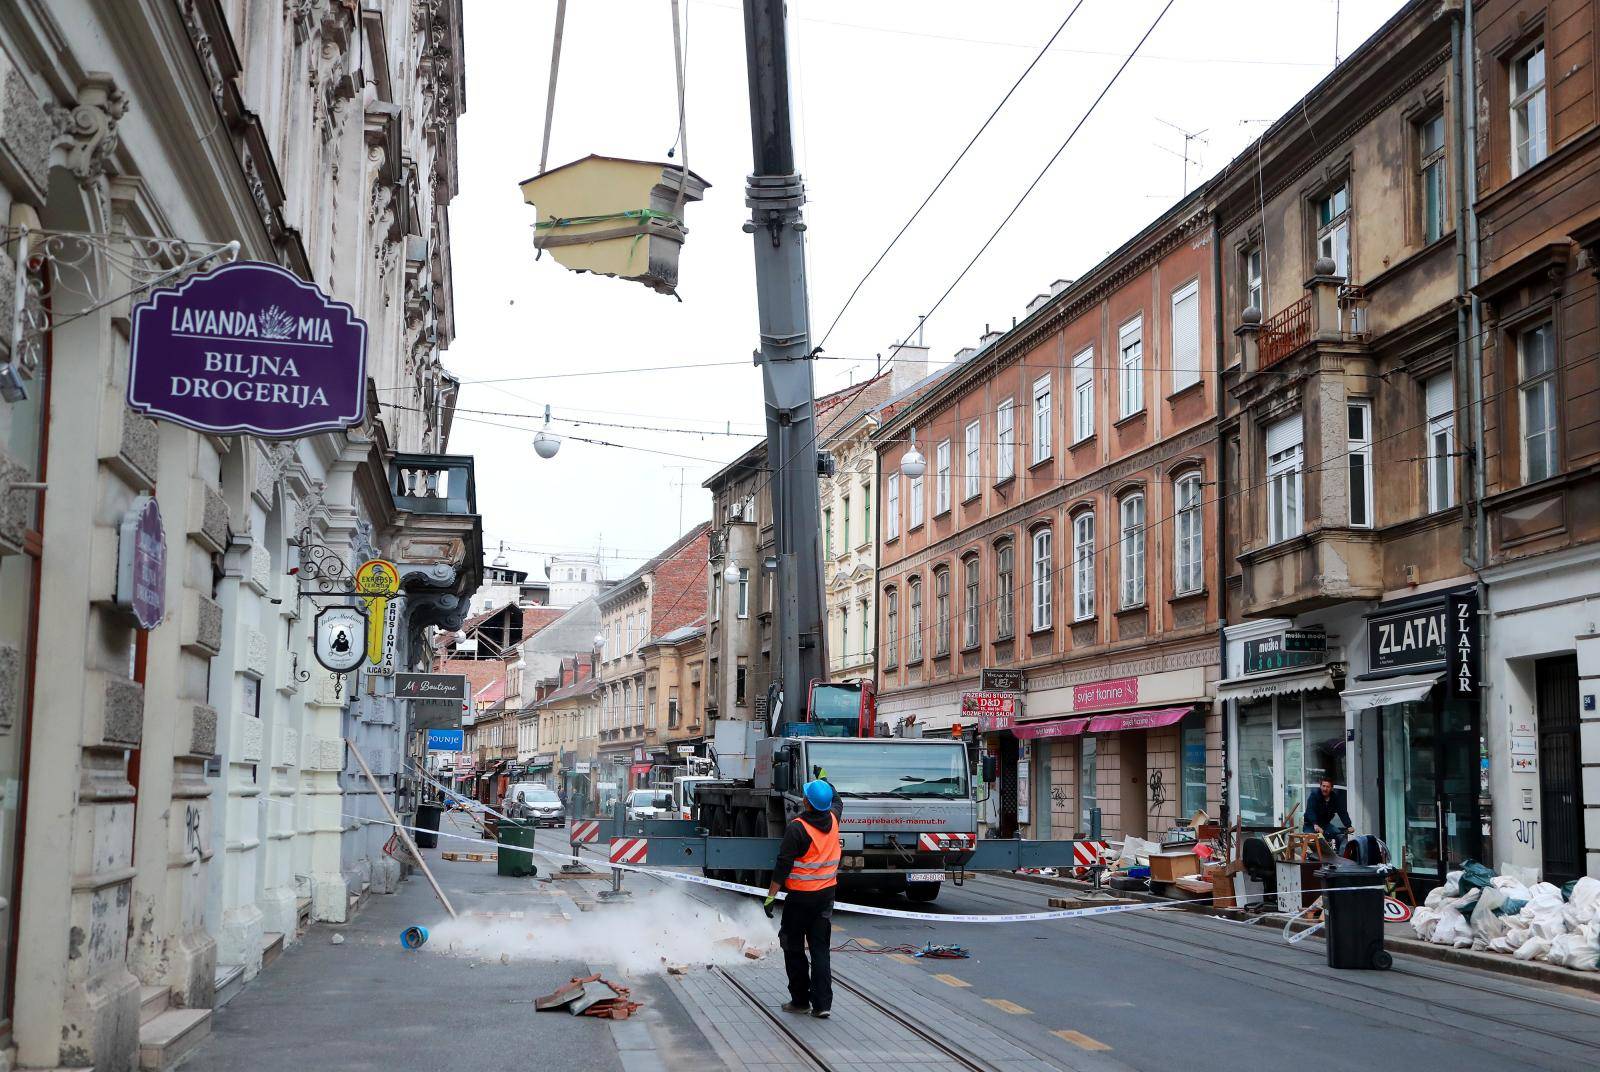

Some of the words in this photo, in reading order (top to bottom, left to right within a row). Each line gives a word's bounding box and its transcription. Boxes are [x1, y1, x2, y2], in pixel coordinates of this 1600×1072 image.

[171, 306, 258, 338] LAVANDA
[297, 316, 333, 343] MIA
[204, 351, 300, 378] BILJNA
[170, 376, 330, 409] DROGERIJA
[386, 602, 397, 666] BRUSIONICA
[1457, 603, 1472, 692] ZLATAR
[366, 666, 382, 674] ILICA
[382, 667, 391, 675] 53
[980, 698, 1000, 707] D&D
